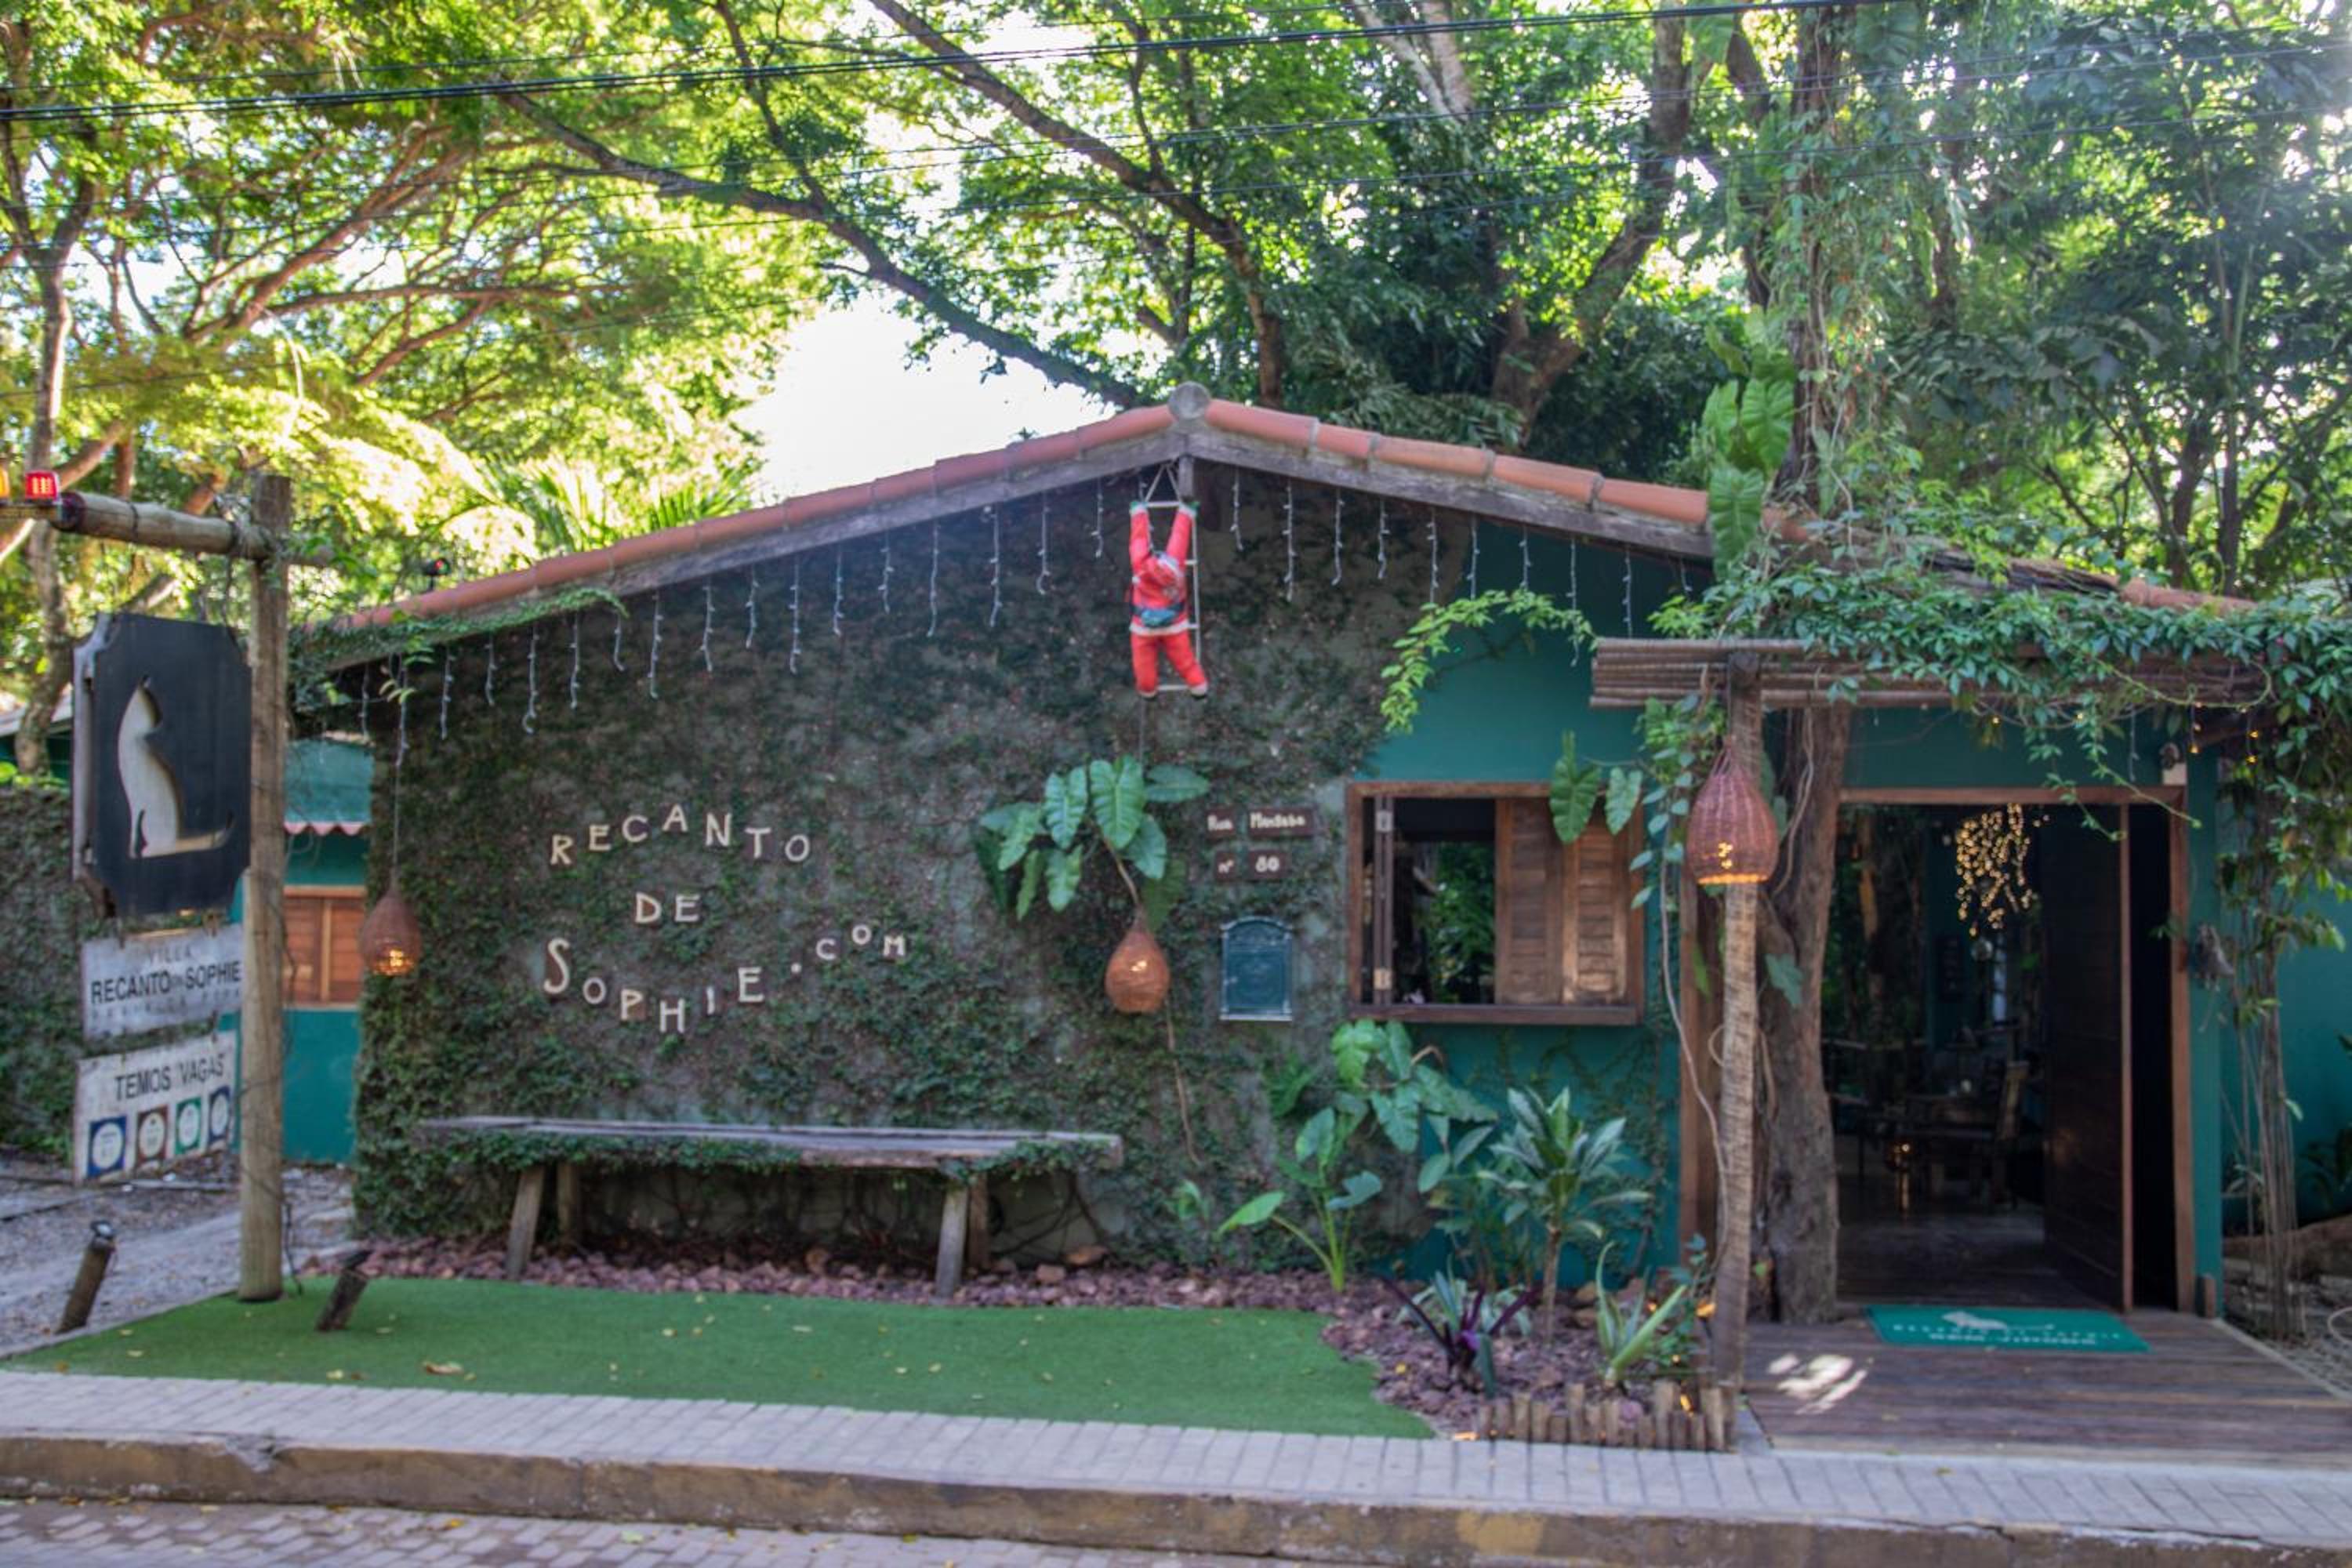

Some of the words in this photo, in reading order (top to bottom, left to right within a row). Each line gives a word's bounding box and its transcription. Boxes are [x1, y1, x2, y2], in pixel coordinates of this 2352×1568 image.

[550, 803, 811, 865] RECANTO
[635, 892, 702, 924] DE
[90, 968, 171, 1004] RECANTO
[184, 960, 242, 990] SOPHIE
[115, 1065, 172, 1101] TEMOS
[178, 1054, 226, 1085] VAGAS
